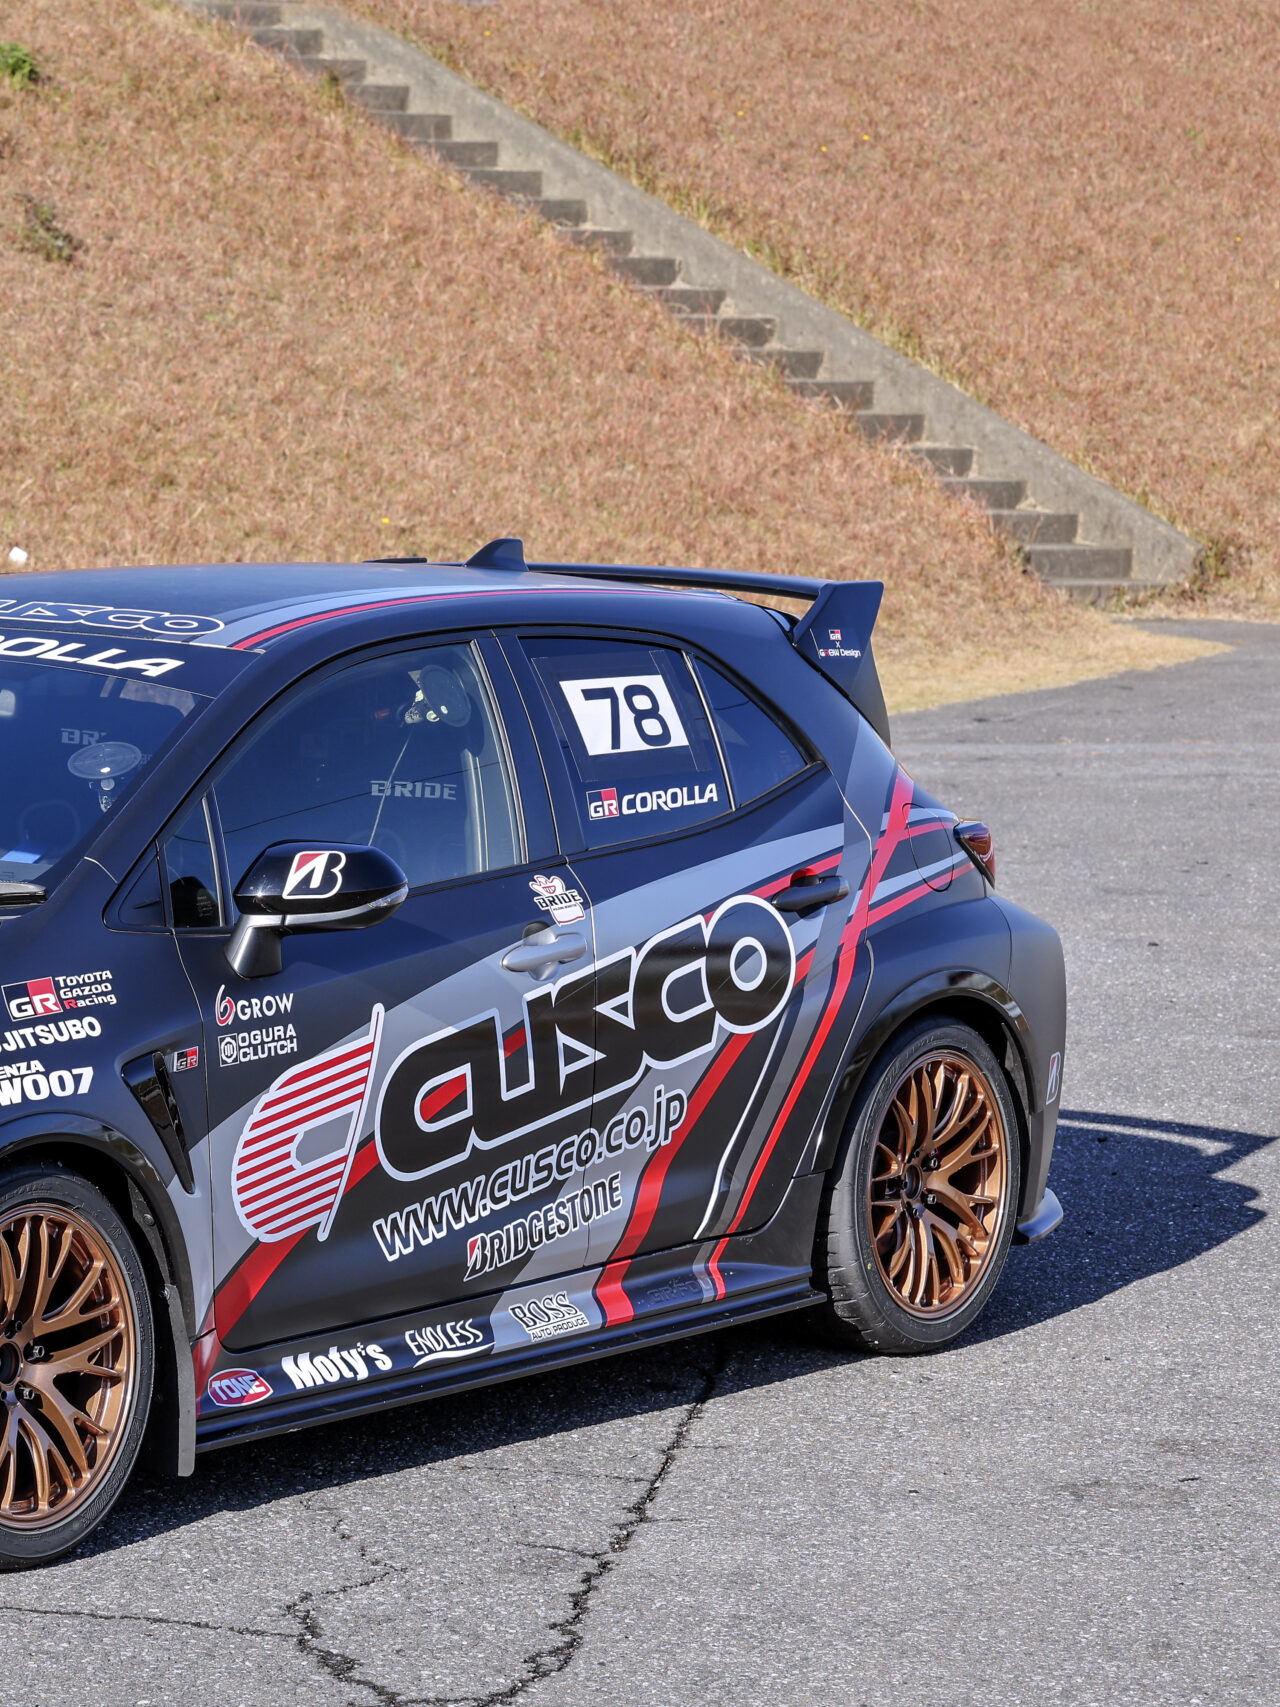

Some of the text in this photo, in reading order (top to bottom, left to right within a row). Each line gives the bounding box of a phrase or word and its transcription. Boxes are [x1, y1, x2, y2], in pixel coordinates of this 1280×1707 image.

[580, 684, 672, 750] 78
[370, 780, 457, 800] BRIDE
[622, 783, 718, 815] COROLLA
[534, 889, 582, 909] BRIDE
[9, 970, 113, 1019] GR TOYOTA
[59, 982, 112, 999] GAZOO
[64, 992, 117, 1010] Racing
[236, 993, 294, 1020] GROW
[238, 1023, 297, 1047] OGURA
[375, 894, 797, 1182] CUSCO
[240, 1038, 298, 1062] CLUTCH
[372, 1083, 687, 1262] www.cusco.co.jp
[463, 1171, 623, 1282] BRIDGESTONE
[508, 1291, 580, 1330] BOSS
[404, 1318, 484, 1356] ENDLESS
[531, 1316, 588, 1341] AUTO PRODUCE
[281, 1342, 393, 1390] Moty's
[211, 1374, 267, 1401] TONE
